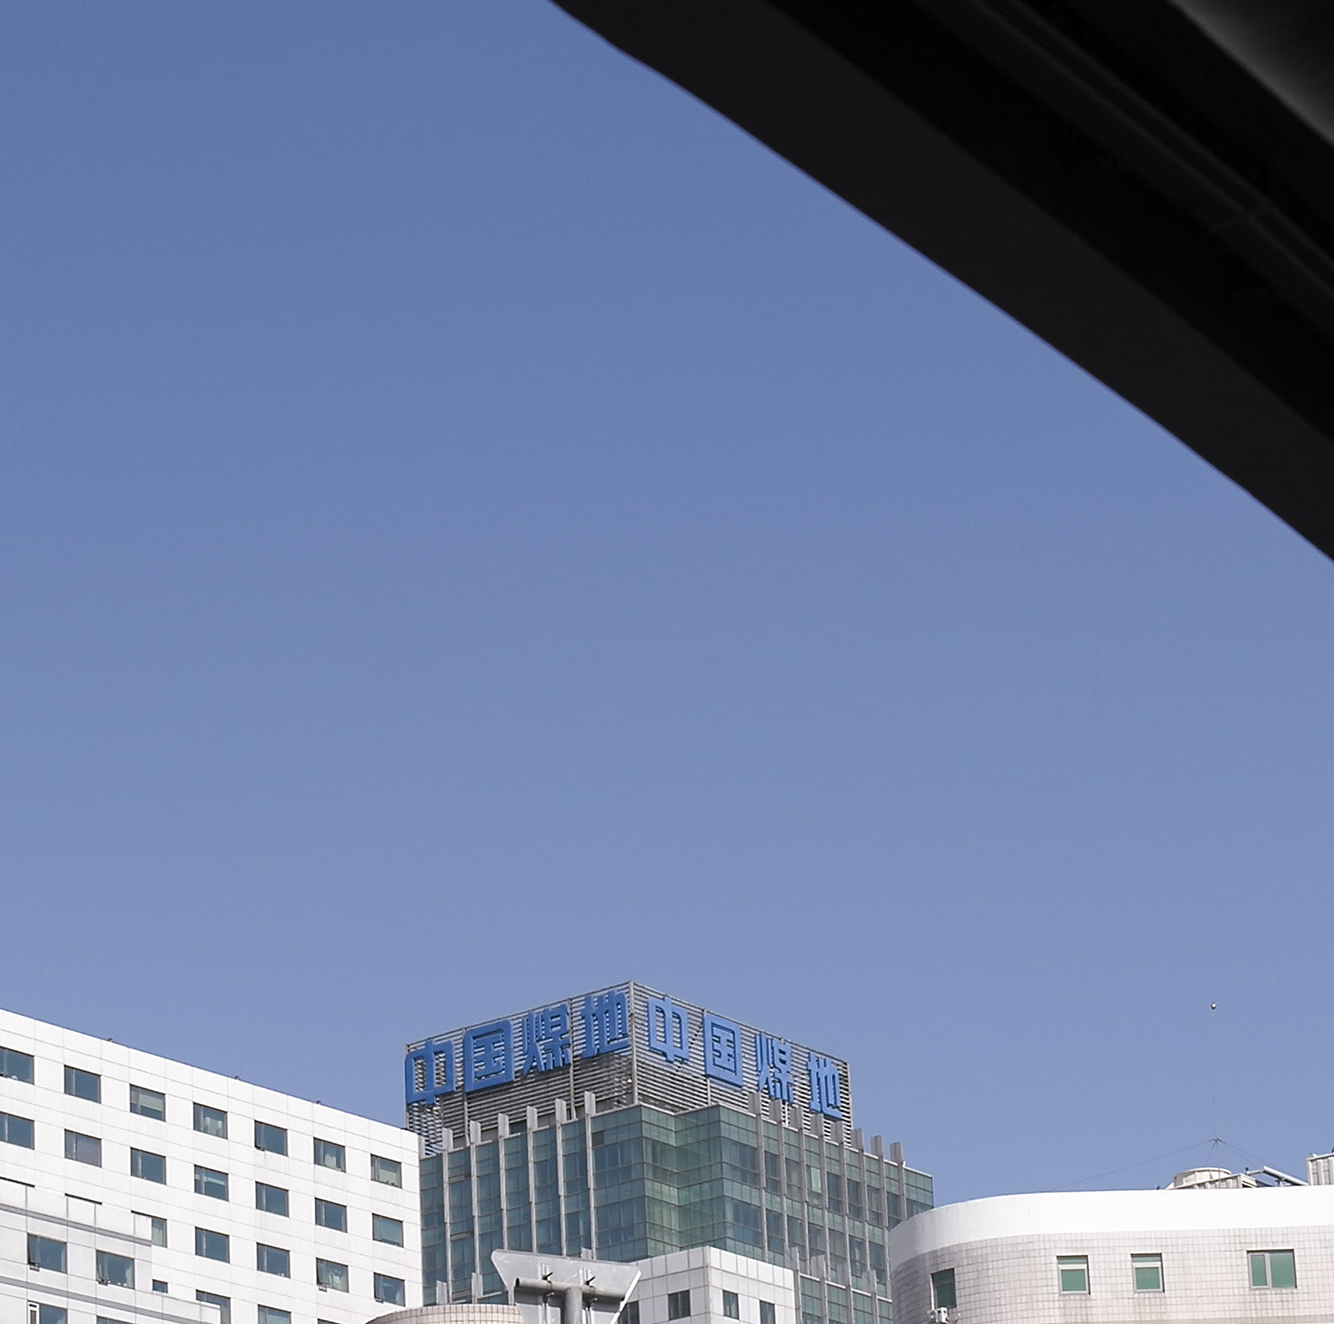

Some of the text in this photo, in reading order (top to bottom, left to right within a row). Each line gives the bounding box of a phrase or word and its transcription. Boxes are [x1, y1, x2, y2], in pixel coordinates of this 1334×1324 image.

[405, 990, 631, 1105] 中国煤地
[647, 994, 843, 1119] 中国煤地
